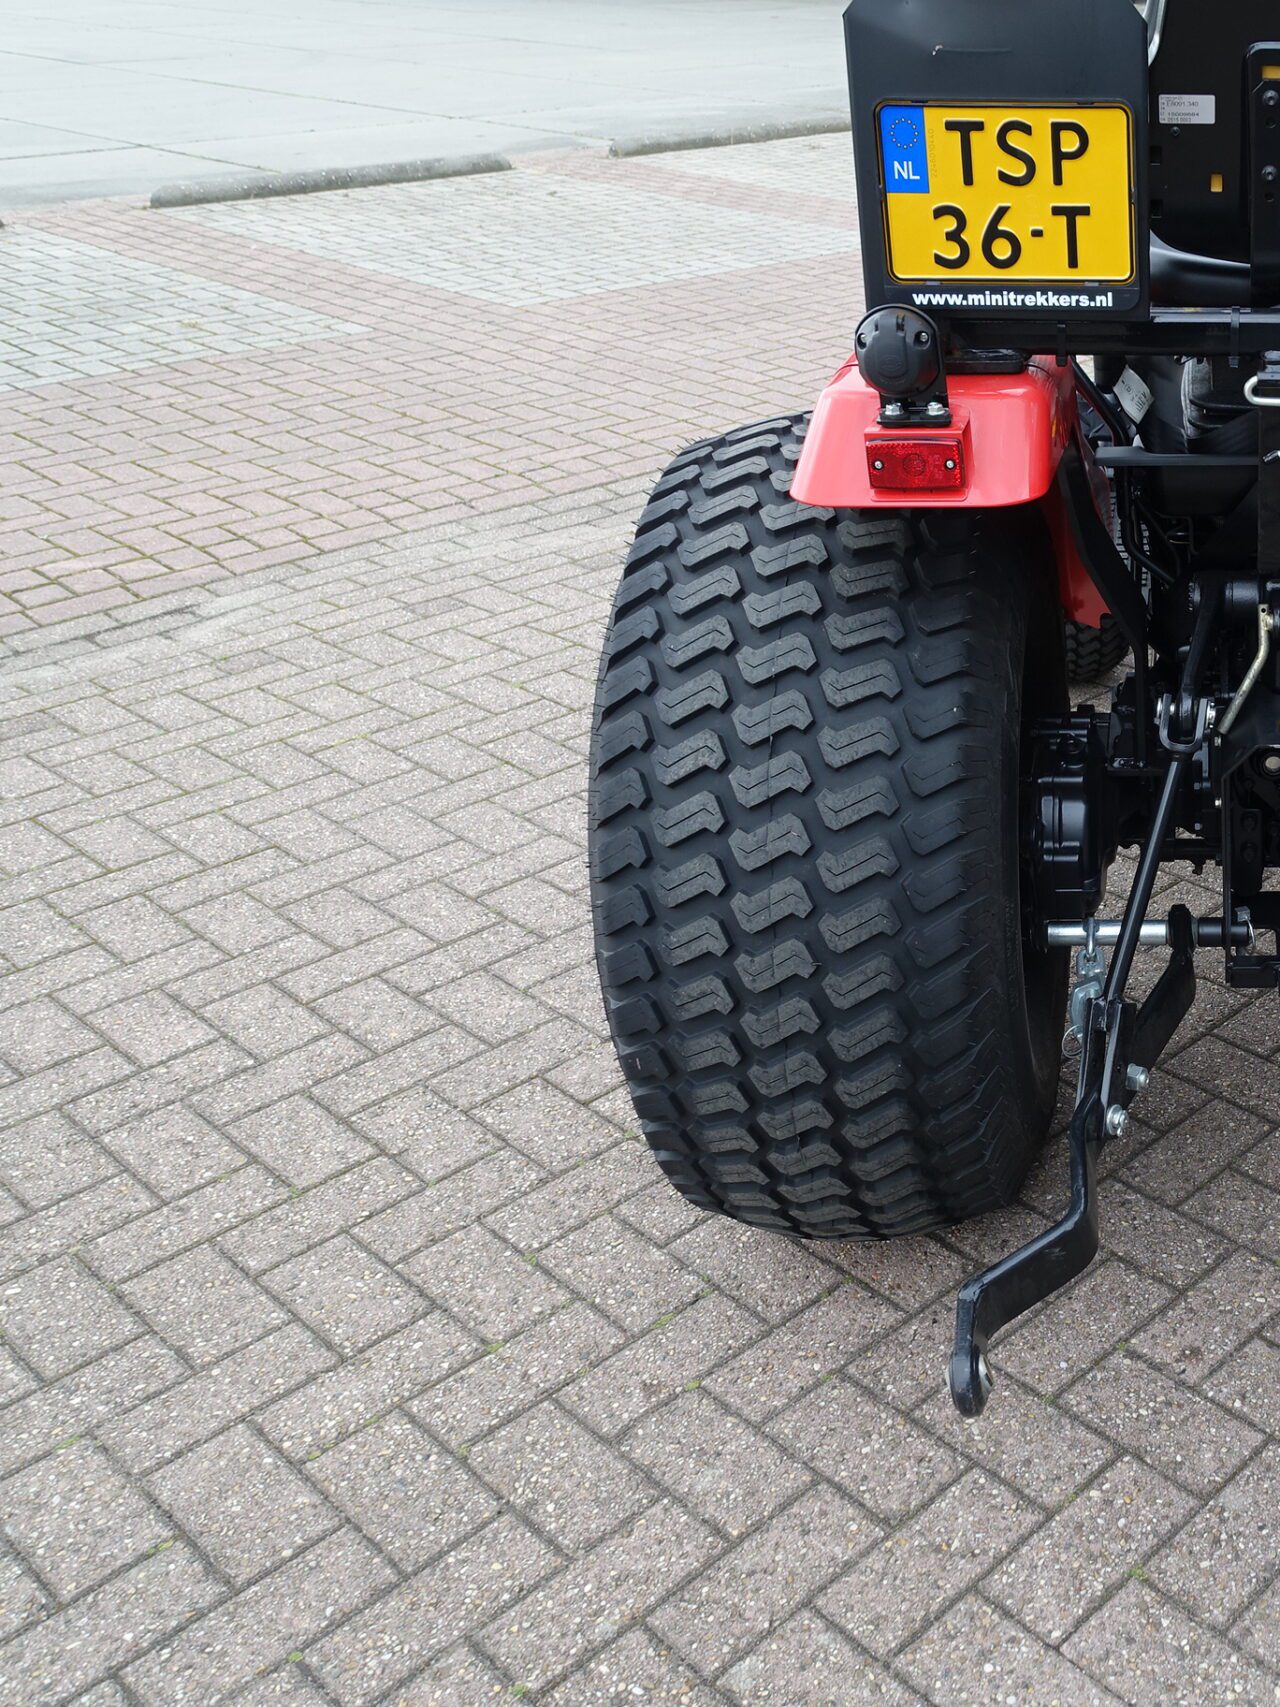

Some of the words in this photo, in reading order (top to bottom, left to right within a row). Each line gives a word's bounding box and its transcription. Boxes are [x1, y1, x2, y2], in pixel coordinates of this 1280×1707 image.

[893, 160, 921, 180] NL
[944, 119, 1089, 186] TSP
[932, 203, 1091, 270] 36-T
[912, 291, 1113, 307] www.minitrekkers.nl
